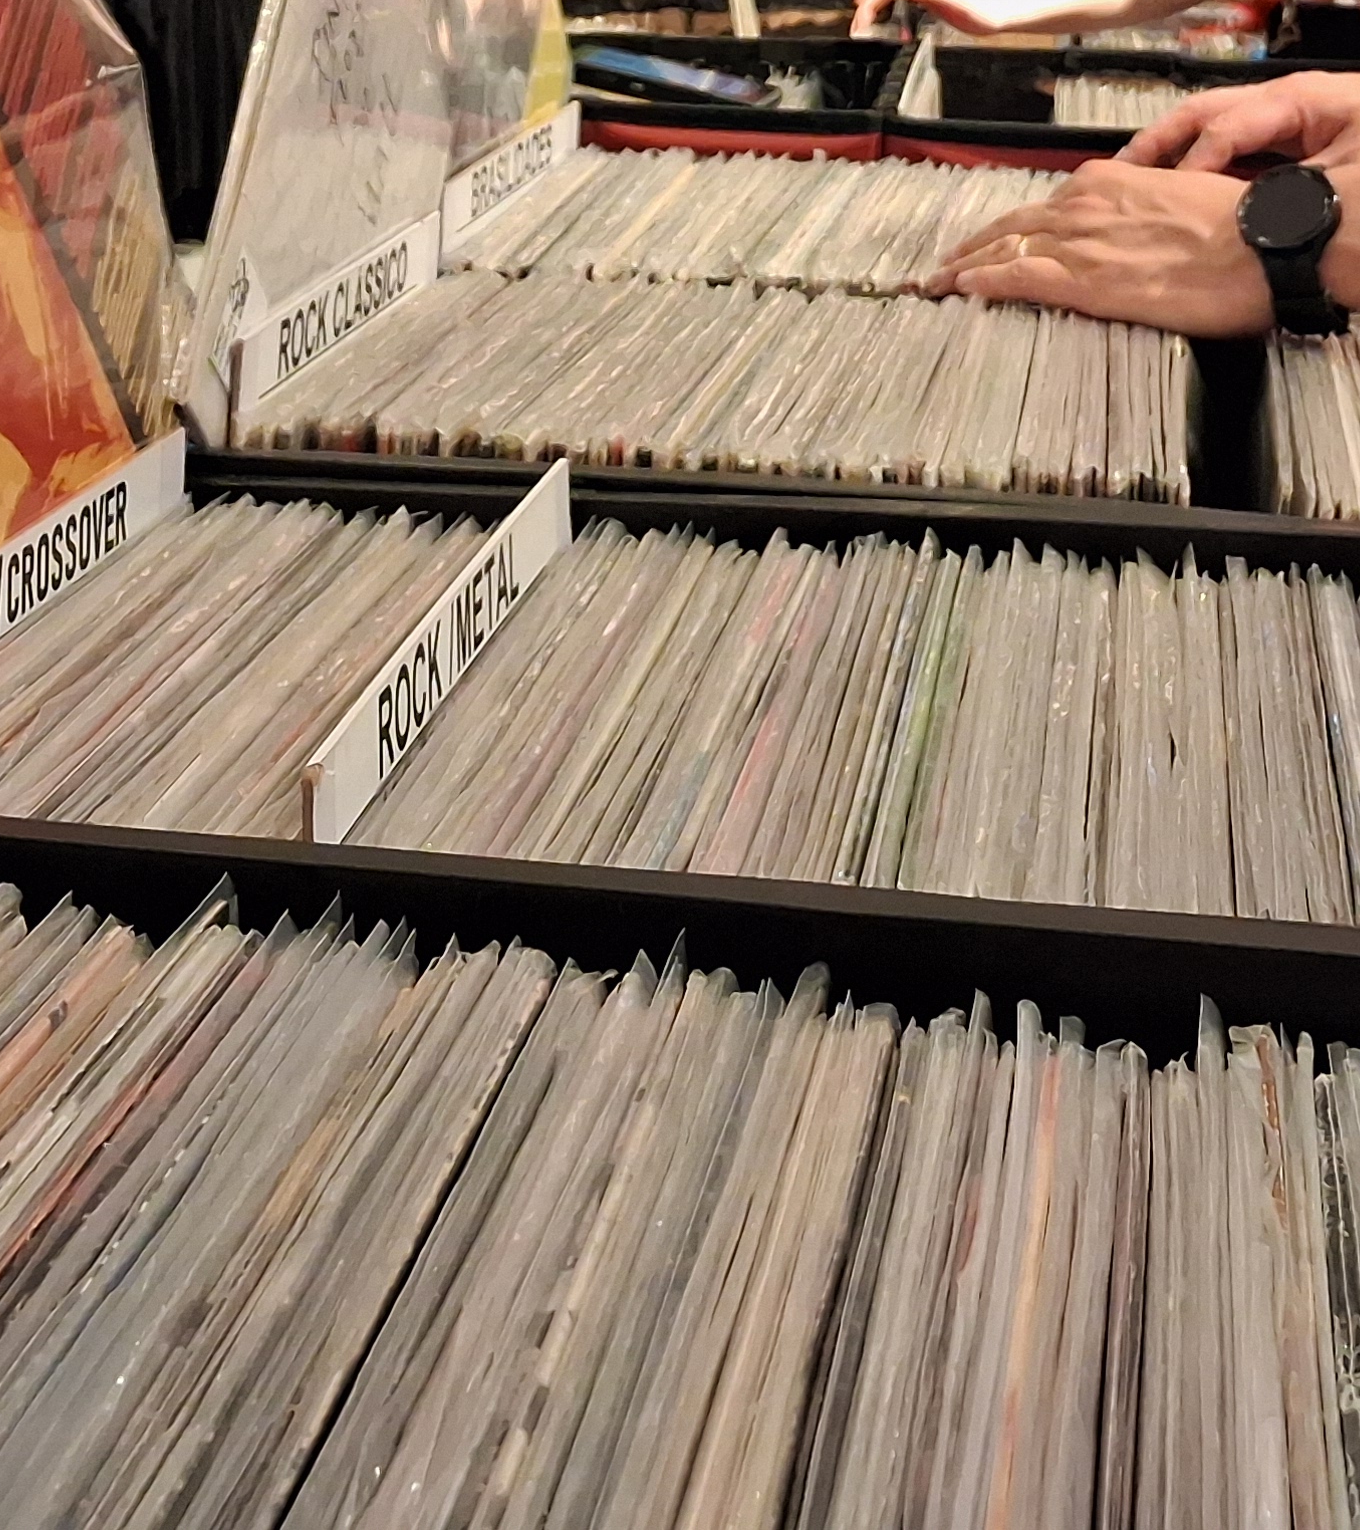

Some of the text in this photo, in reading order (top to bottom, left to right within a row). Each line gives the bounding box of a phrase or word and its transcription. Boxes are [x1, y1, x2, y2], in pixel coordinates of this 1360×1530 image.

[277, 290, 330, 379] ROCK
[332, 240, 409, 338] CLASSICO
[378, 620, 443, 779] ROCK
